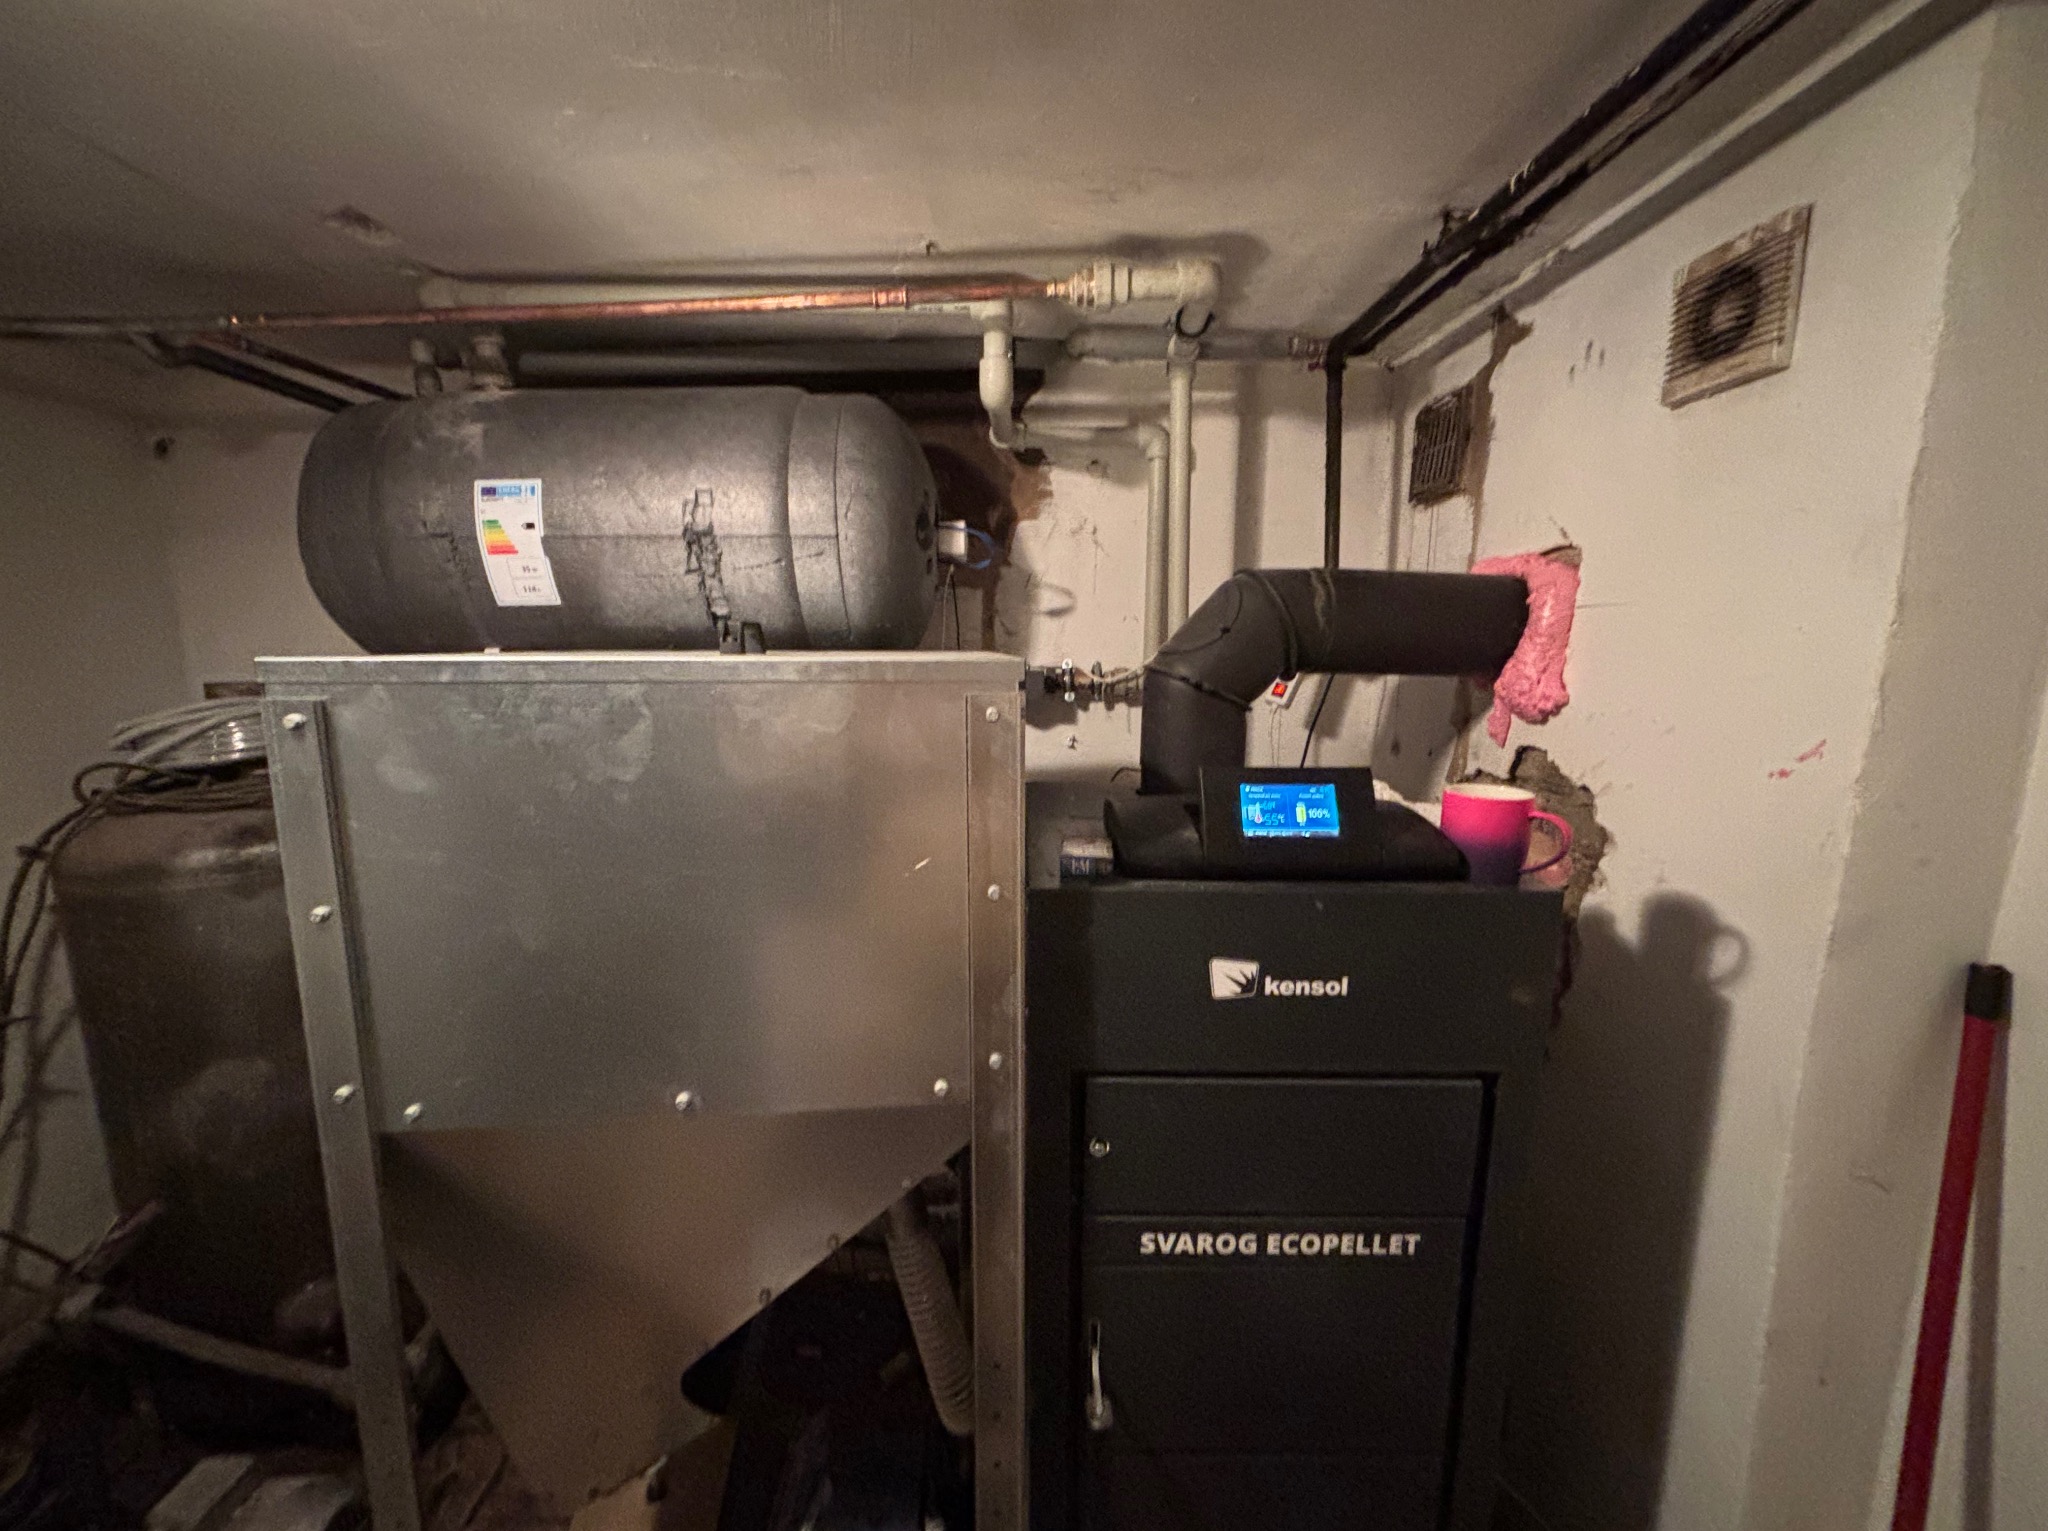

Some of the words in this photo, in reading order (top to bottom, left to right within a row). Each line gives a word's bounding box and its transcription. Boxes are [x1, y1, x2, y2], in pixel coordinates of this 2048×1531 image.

[1307, 807, 1331, 819] 100%
[1264, 974, 1349, 997] kensol
[1139, 1232, 1258, 1256] SVAROG
[1266, 1232, 1421, 1256] ECOPELLET
